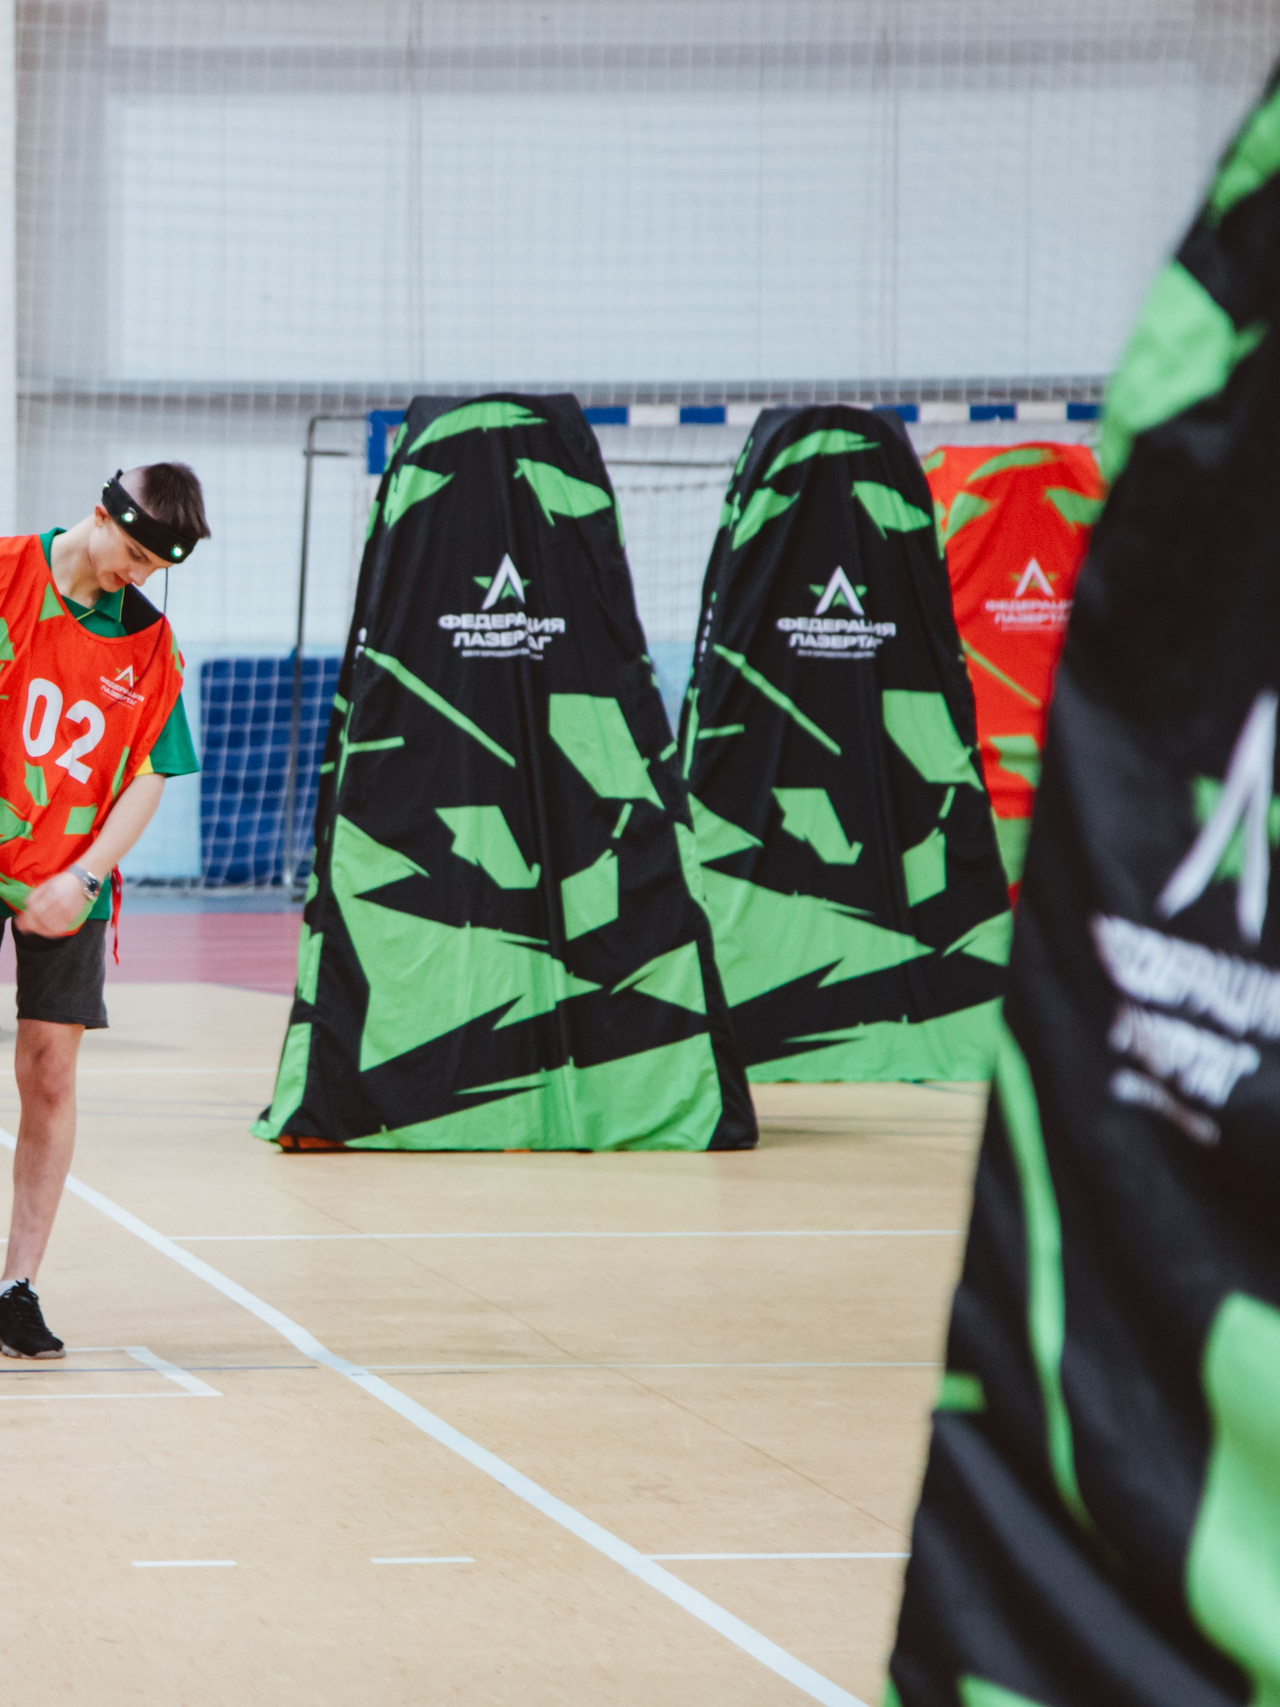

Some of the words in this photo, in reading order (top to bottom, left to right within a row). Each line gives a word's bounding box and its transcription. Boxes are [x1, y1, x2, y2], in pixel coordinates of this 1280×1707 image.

[438, 612, 566, 634] ФЕДЕРАЦИЯ
[453, 629, 553, 651] ЛАЗЕРАГ
[23, 678, 105, 785] 02
